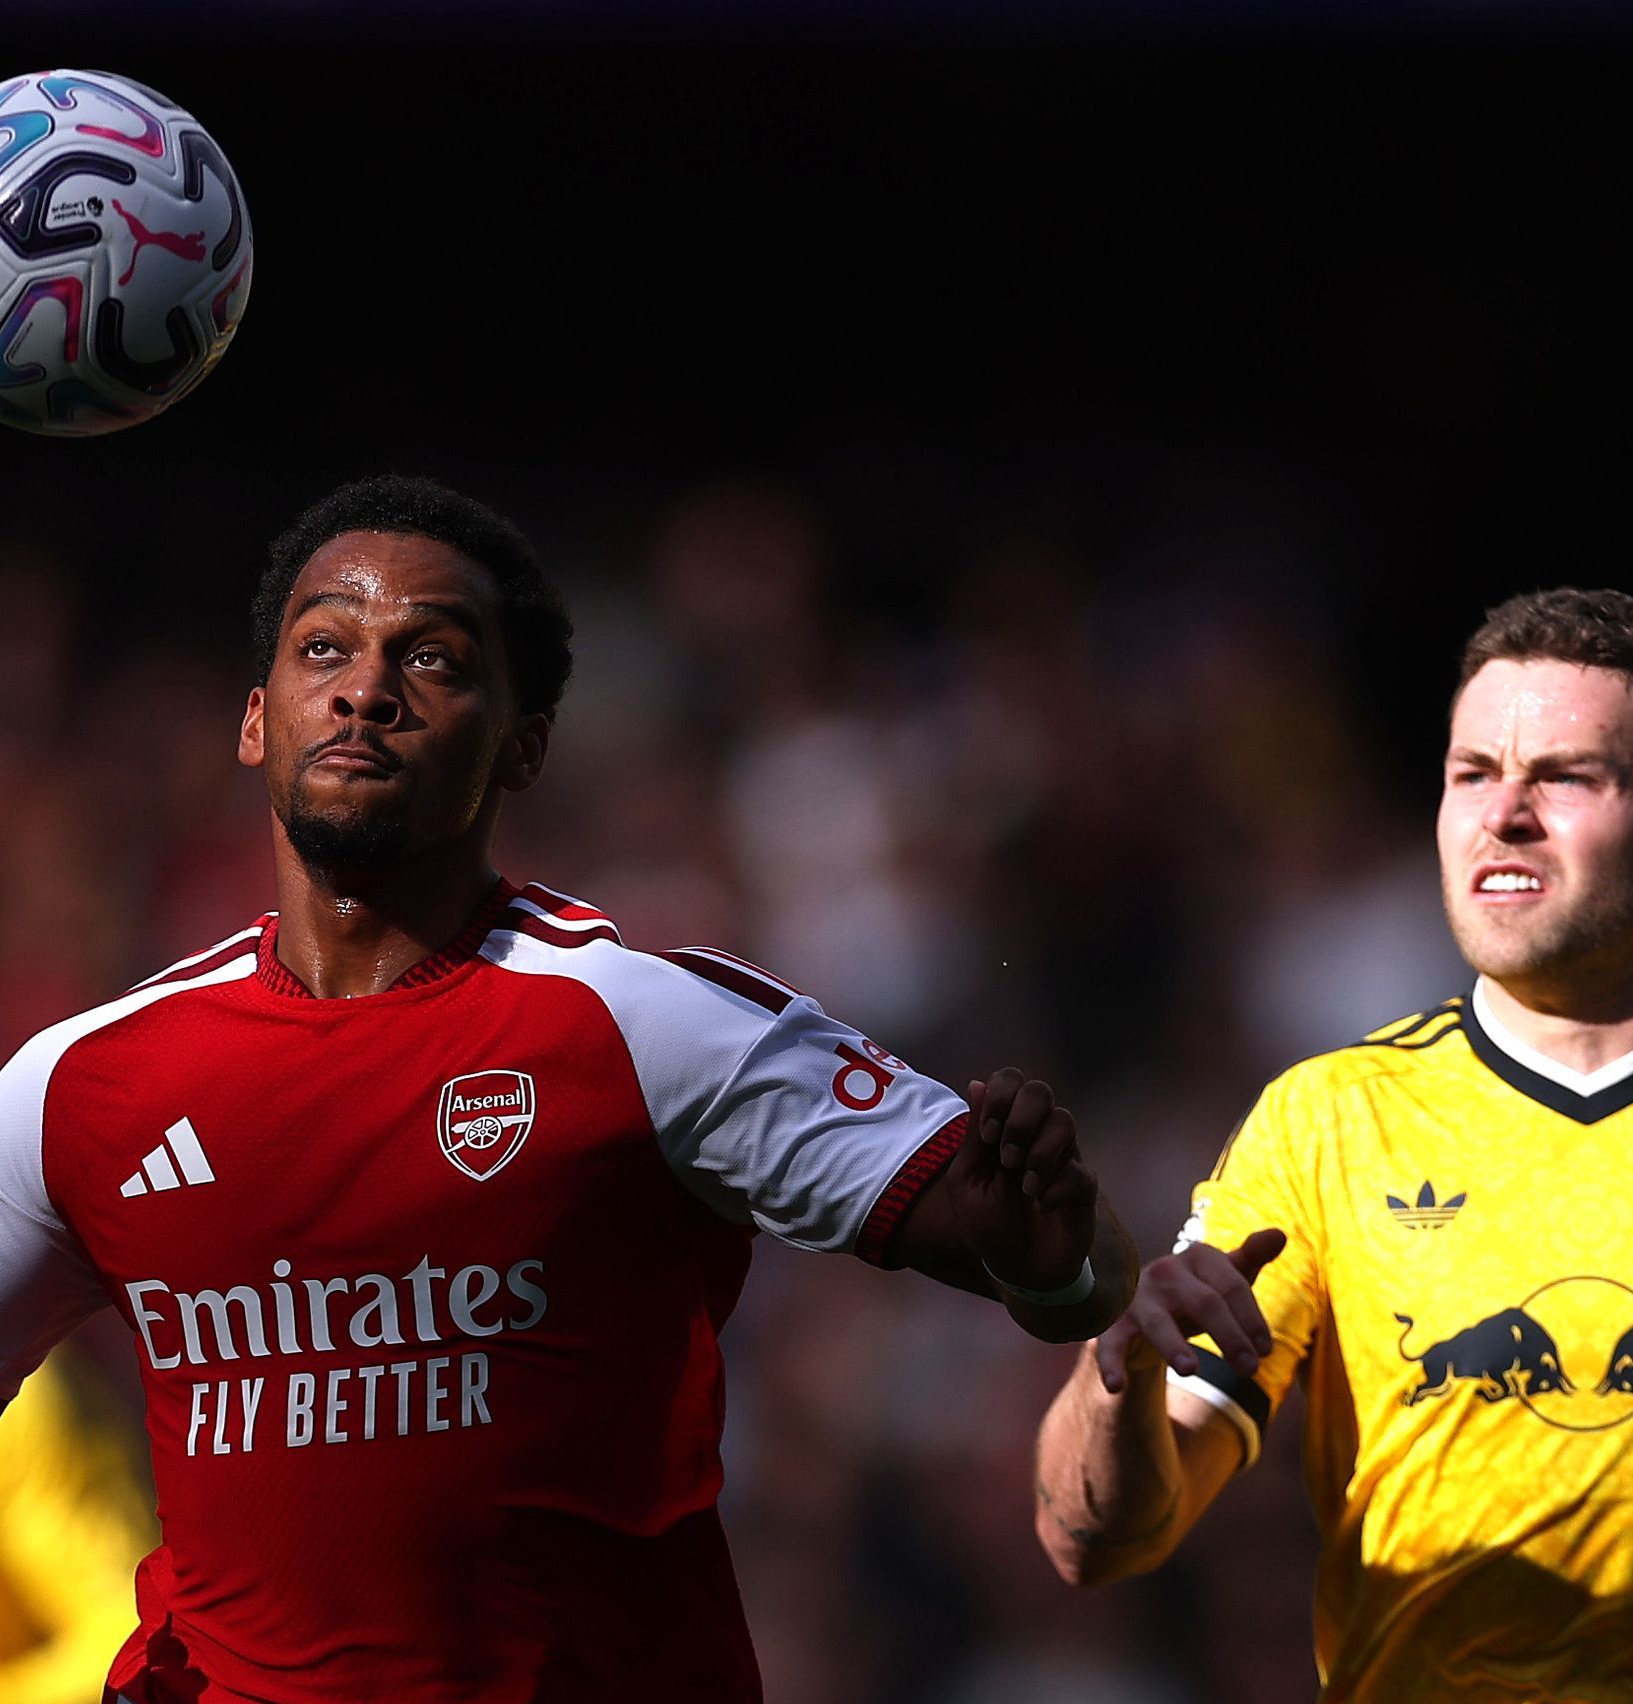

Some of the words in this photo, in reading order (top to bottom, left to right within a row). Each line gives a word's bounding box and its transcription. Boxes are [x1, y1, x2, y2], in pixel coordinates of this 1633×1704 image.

[451, 1089, 521, 1113] Arsenal
[125, 1254, 547, 1370] Emirates
[187, 1377, 264, 1457] FLY
[286, 1353, 492, 1448] BETTER
